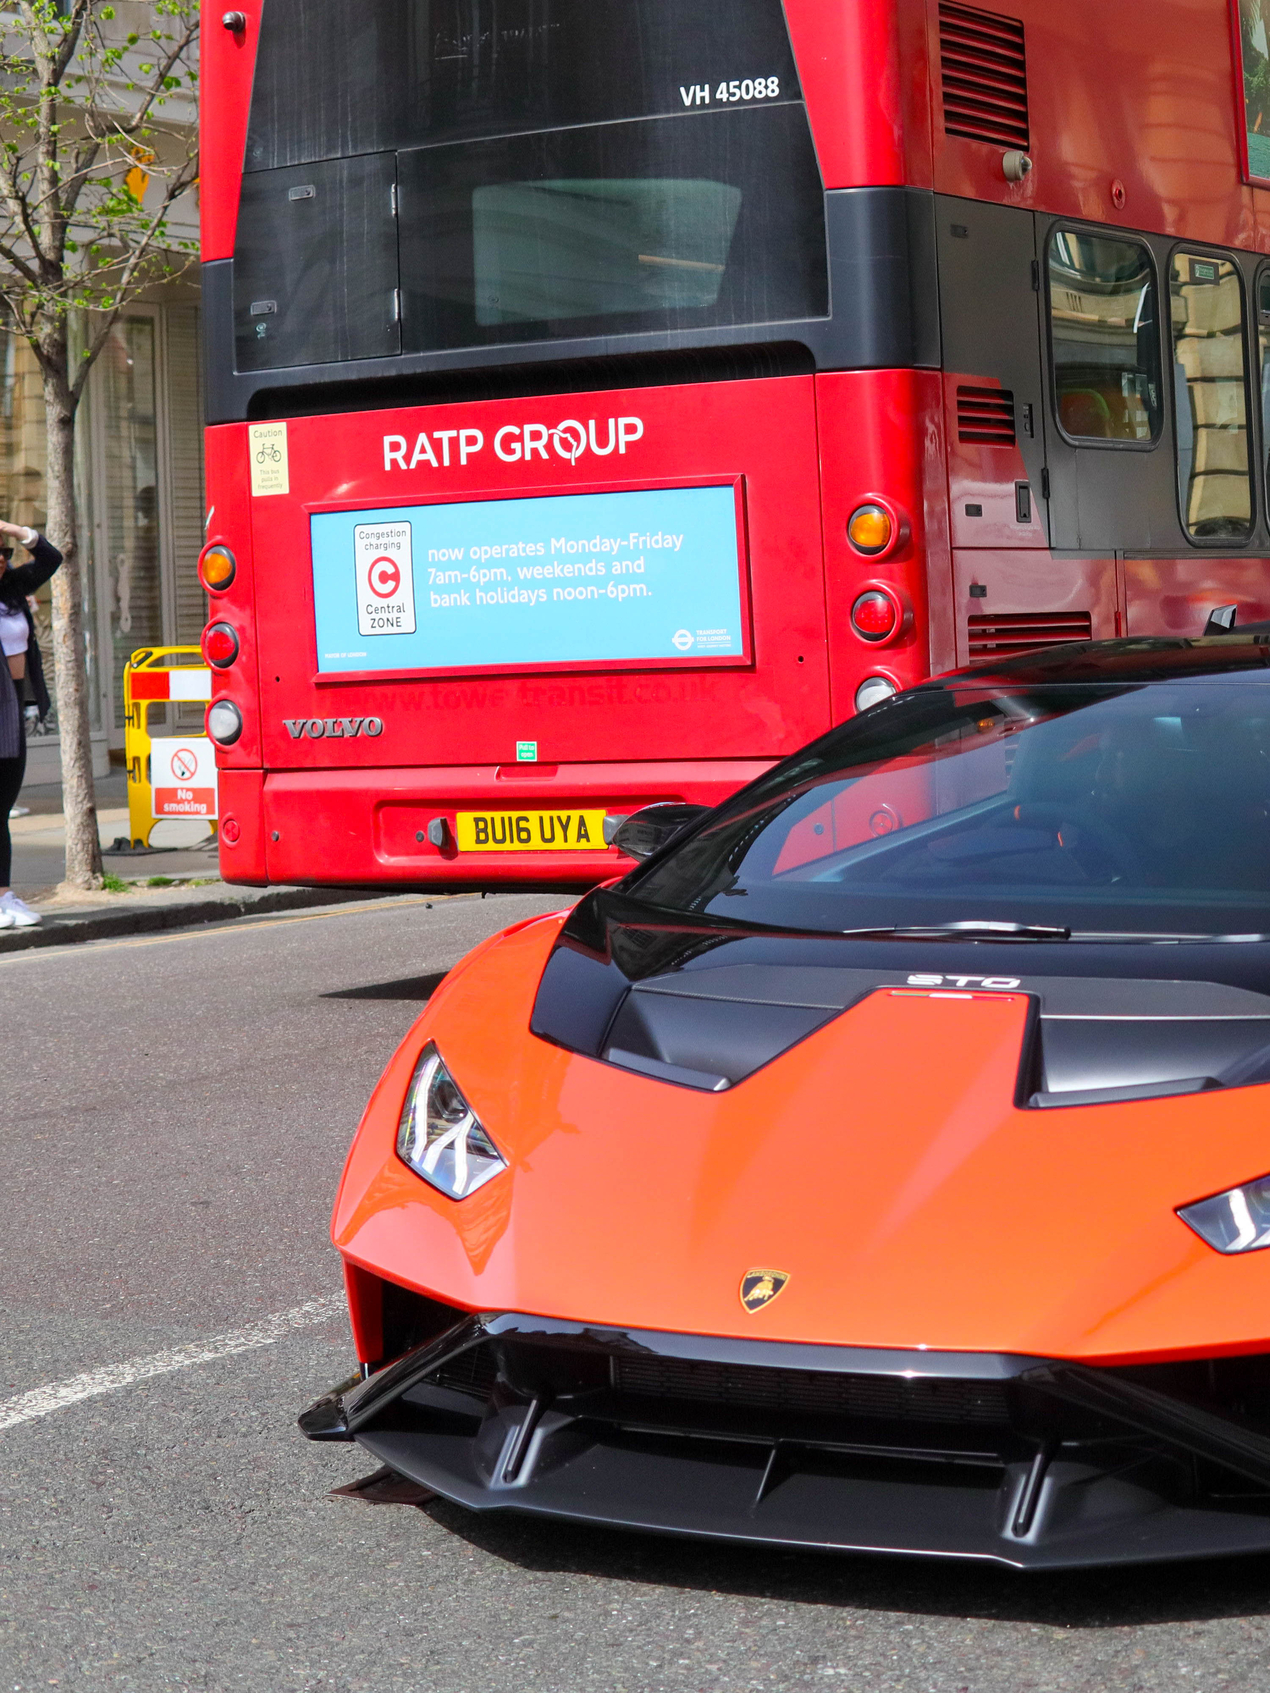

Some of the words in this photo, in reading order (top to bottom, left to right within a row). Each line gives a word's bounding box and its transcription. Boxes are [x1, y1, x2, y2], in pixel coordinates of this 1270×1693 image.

[680, 84, 710, 106] VH
[716, 76, 780, 102] 45088
[253, 429, 283, 438] Caution
[383, 428, 484, 471] RATP
[494, 416, 644, 466] GROUP
[359, 529, 407, 540] Congestion
[364, 541, 402, 551] charging
[428, 546, 464, 562] now
[469, 540, 545, 563] operates
[550, 531, 684, 555] Monday-Friday
[427, 565, 512, 586] 7am-6pm,
[517, 559, 606, 580] weekends
[611, 556, 645, 575] and
[430, 589, 471, 608] bank
[475, 585, 547, 606] holidays
[553, 581, 652, 602] noon-6pm.
[366, 602, 406, 615] Central
[370, 617, 402, 629] ZONE
[696, 628, 727, 636] TRANSPORT
[283, 716, 384, 739] VOLVO
[177, 788, 193, 800] No
[163, 801, 207, 814] smoking
[473, 816, 532, 845] BU16
[539, 815, 591, 844] UYA
[906, 974, 1021, 989] STO
